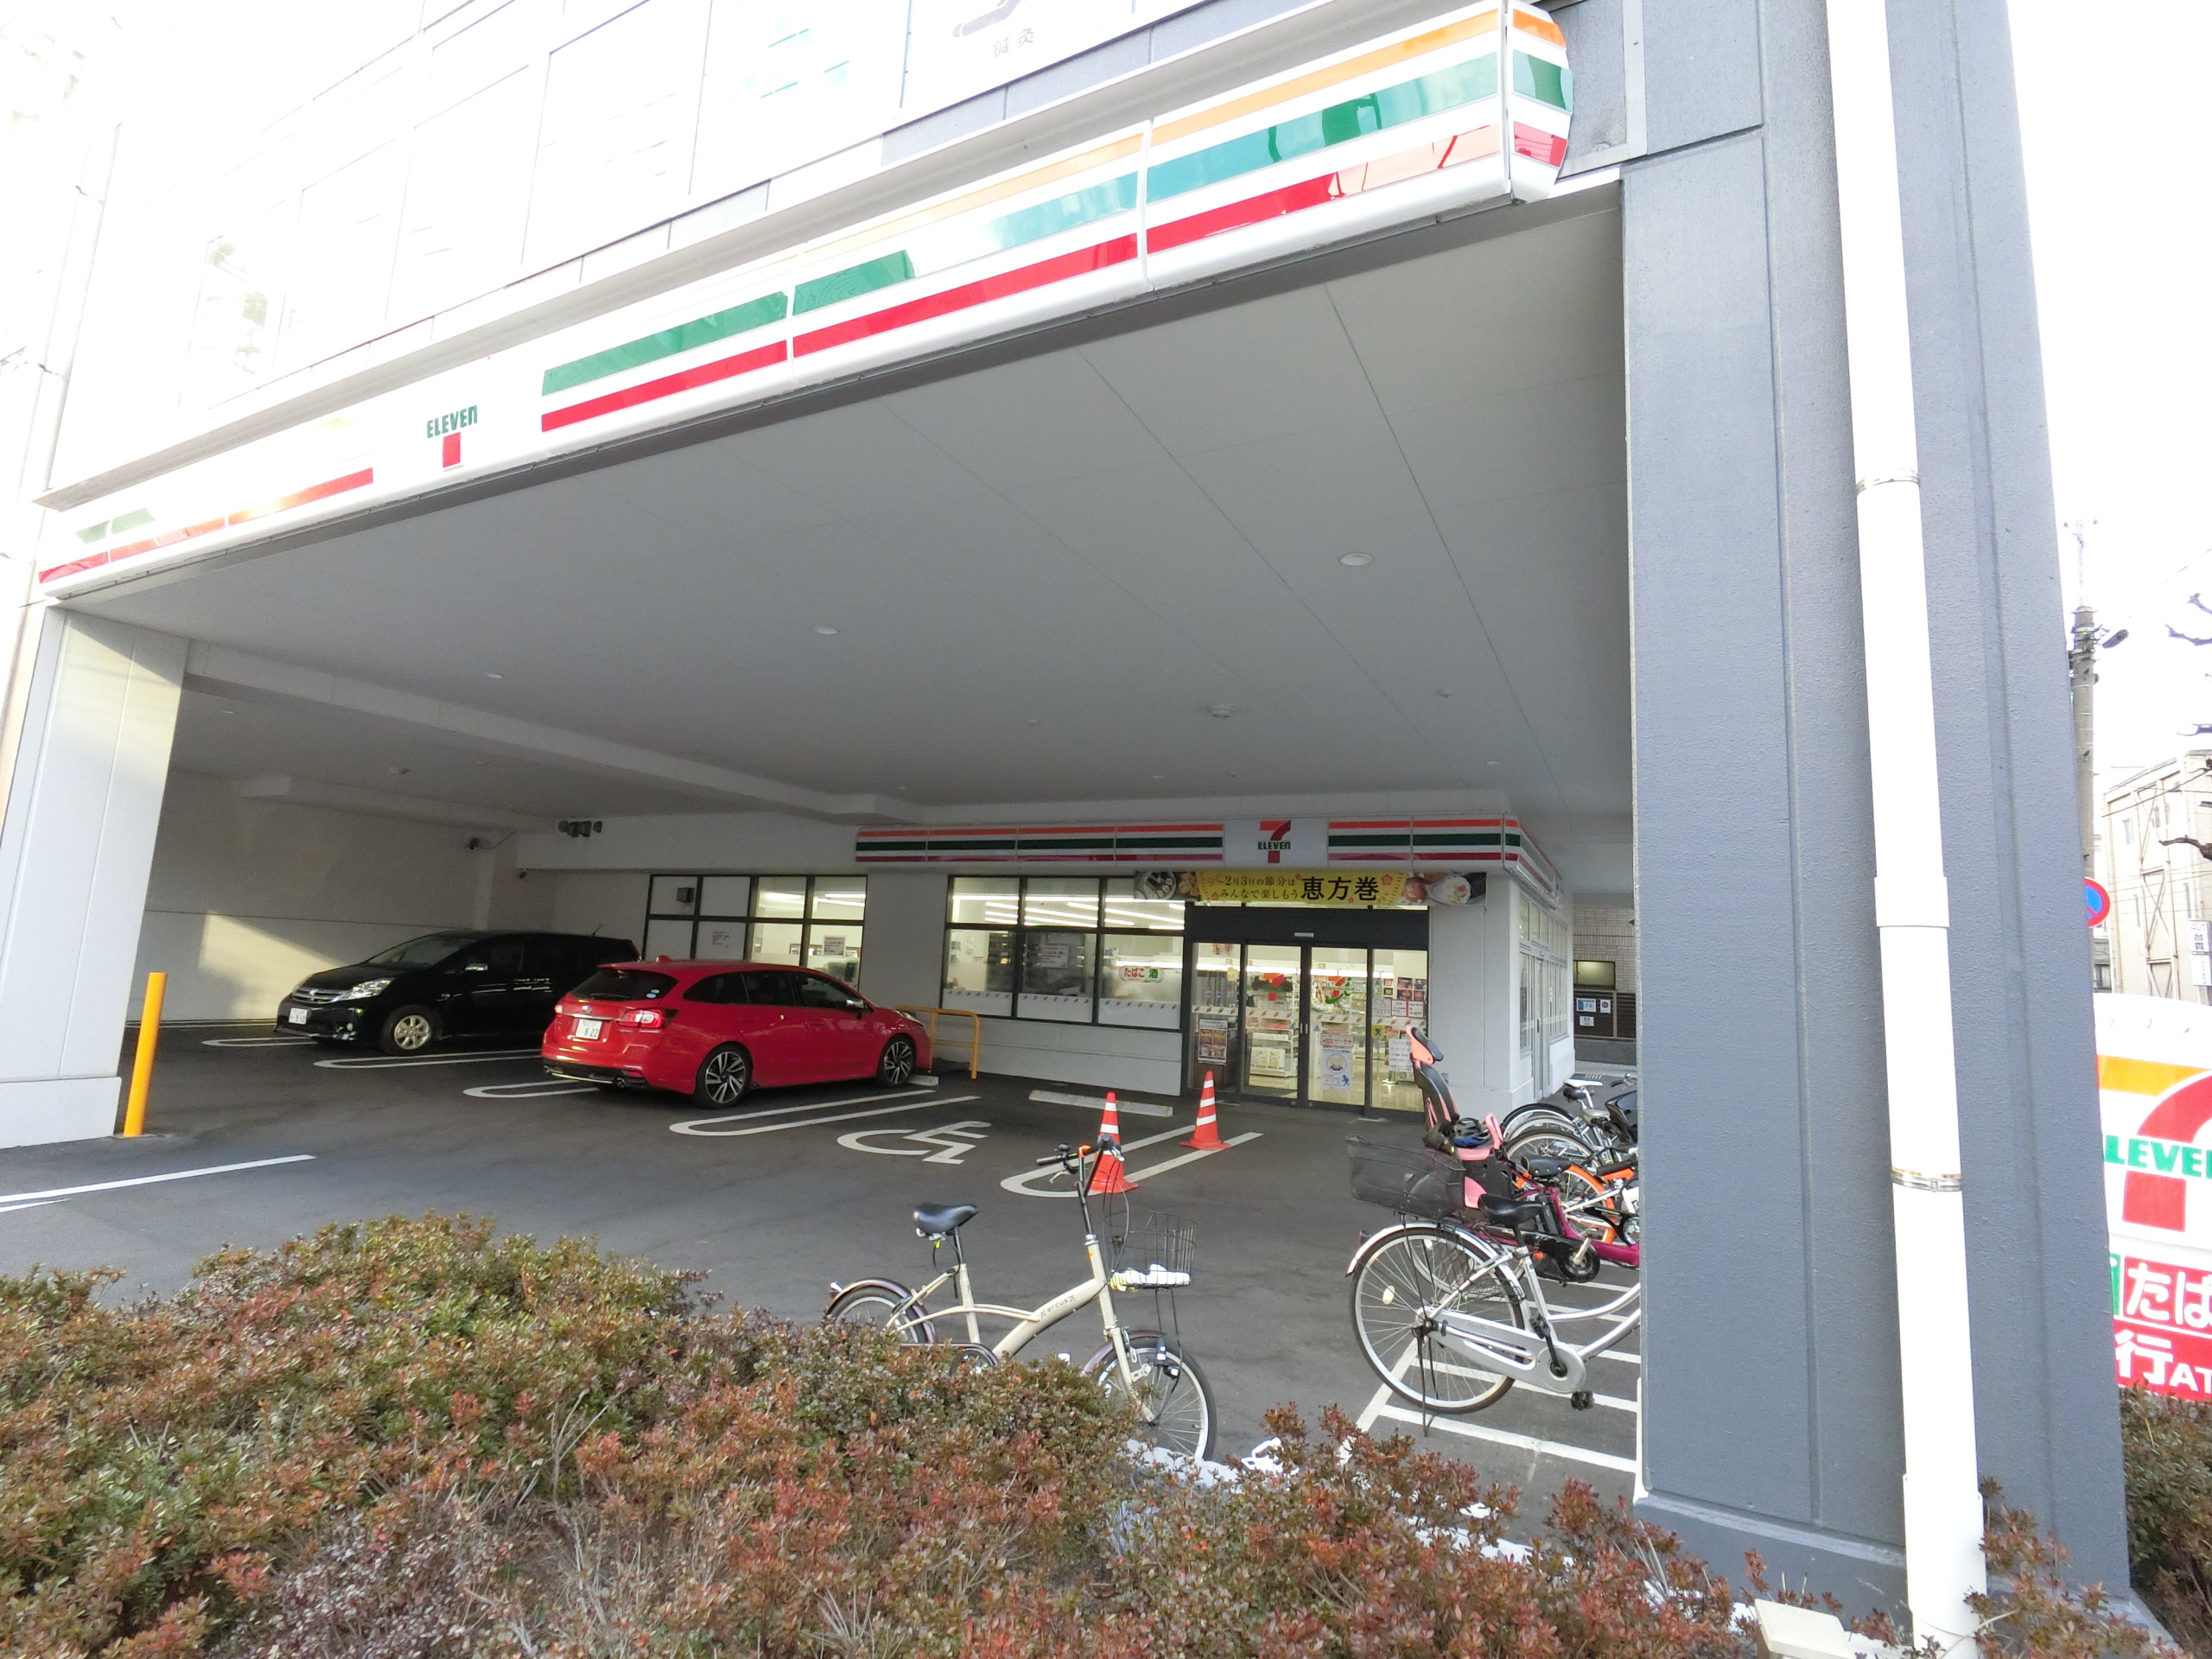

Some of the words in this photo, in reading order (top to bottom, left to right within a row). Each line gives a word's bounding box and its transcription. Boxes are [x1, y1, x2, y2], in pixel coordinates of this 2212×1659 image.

[1225, 875, 1295, 887] 2月3日の節分は
[1220, 889, 1298, 899] みんなで楽しもう
[1300, 876, 1379, 901] 恵方巻
[1124, 968, 1145, 977] たばこ
[1148, 968, 1159, 978] 酒
